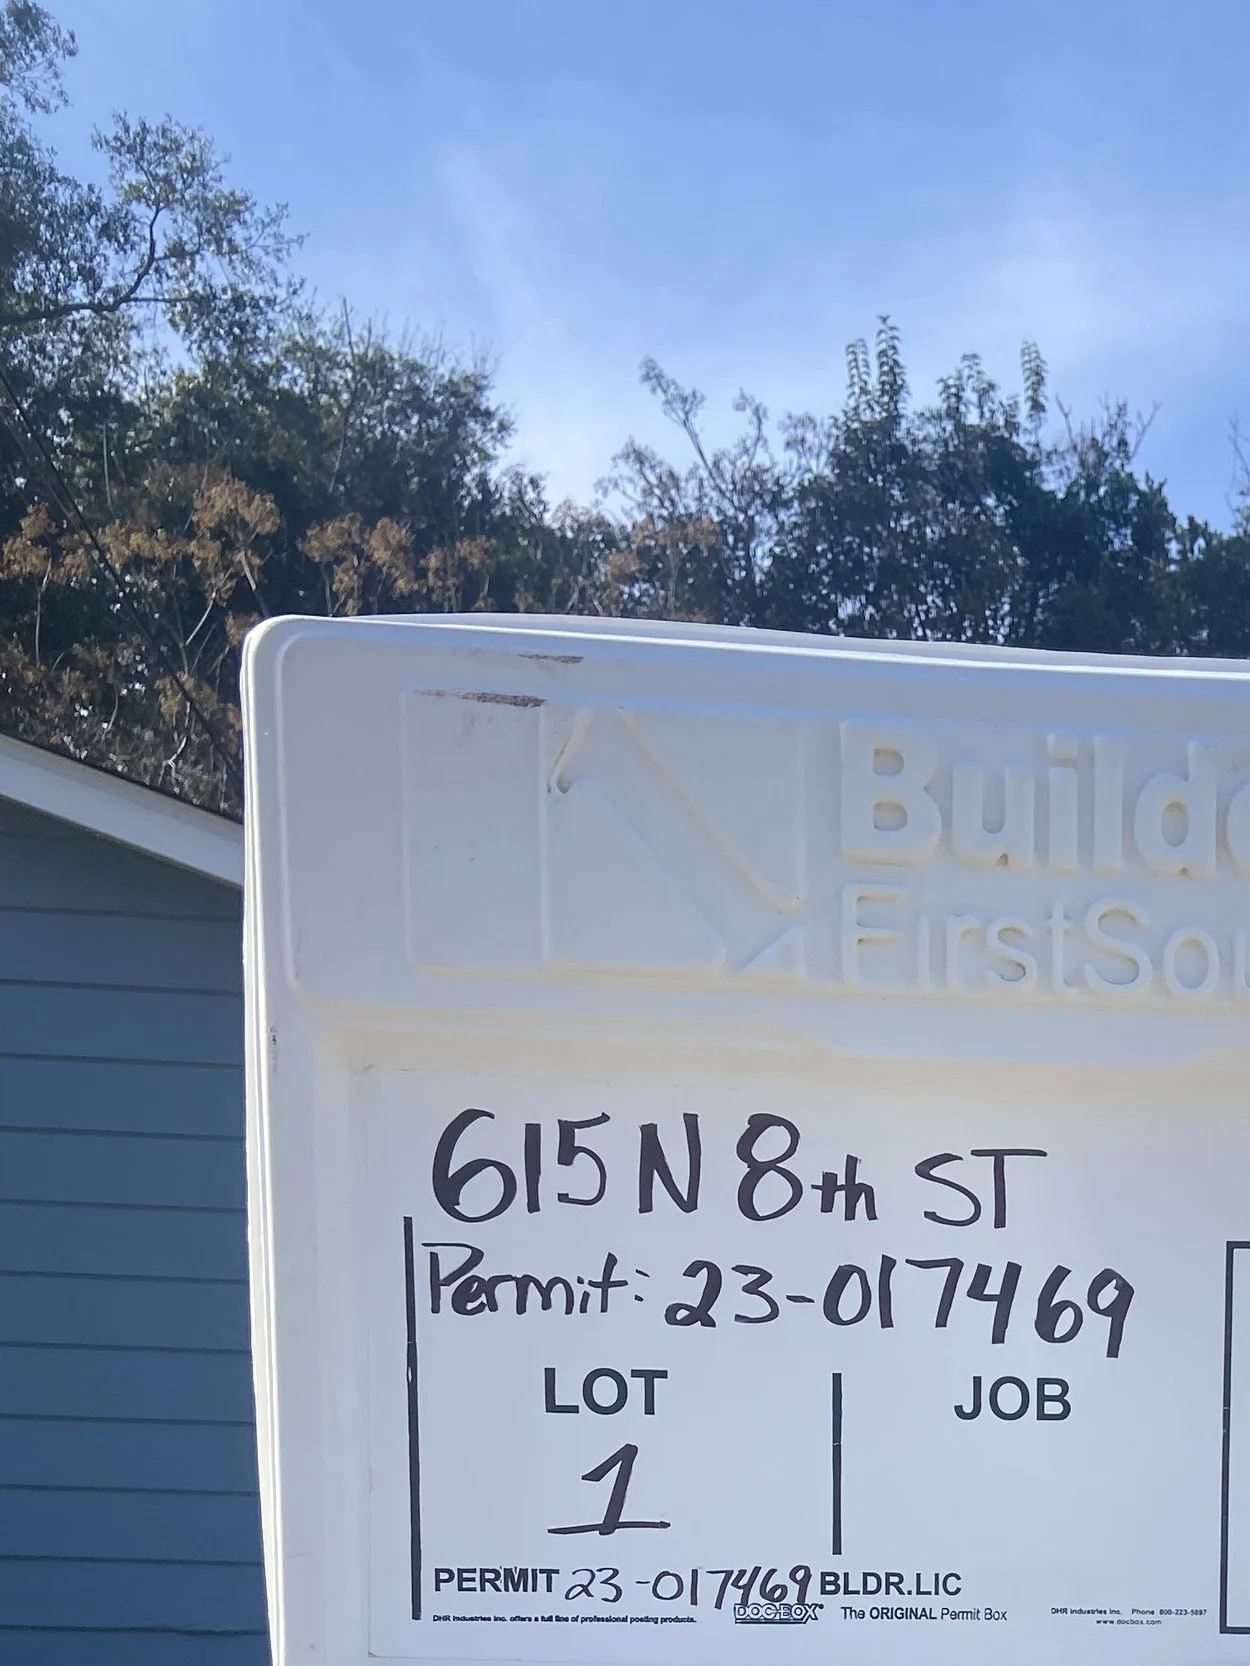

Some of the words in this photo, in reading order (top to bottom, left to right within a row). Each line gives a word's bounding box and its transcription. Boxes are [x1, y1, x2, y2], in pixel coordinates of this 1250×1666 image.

[433, 1109, 610, 1223] 615
[639, 1113, 701, 1214] N
[737, 1113, 878, 1221] 8th
[915, 1149, 1047, 1228] ST
[422, 1243, 649, 1316] Permit:
[665, 1254, 1134, 1358] 23-017469
[545, 1368, 668, 1415] LOT
[954, 1376, 1071, 1420] JOB
[548, 1444, 670, 1535] 1
[435, 1567, 559, 1592] PERMIT
[564, 1564, 812, 1611] 23-017469
[821, 1572, 961, 1595] BLDR.LIC
[432, 1614, 451, 1623] DHR
[452, 1614, 492, 1623] Industries
[493, 1614, 508, 1623] Inc.
[509, 1614, 533, 1624] offers
[541, 1614, 554, 1624] full
[555, 1614, 570, 1624] line
[571, 1614, 580, 1625] of
[581, 1614, 629, 1625] professional
[630, 1615, 660, 1625] posting
[661, 1615, 698, 1625] products.
[840, 1606, 867, 1622] The
[869, 1606, 938, 1622] ORIGINAL
[940, 1608, 982, 1622] Permit
[984, 1608, 1008, 1622] Box
[1050, 1607, 1068, 1616] DHR
[1069, 1607, 1107, 1616] Industries
[1131, 1608, 1155, 1617] Phone
